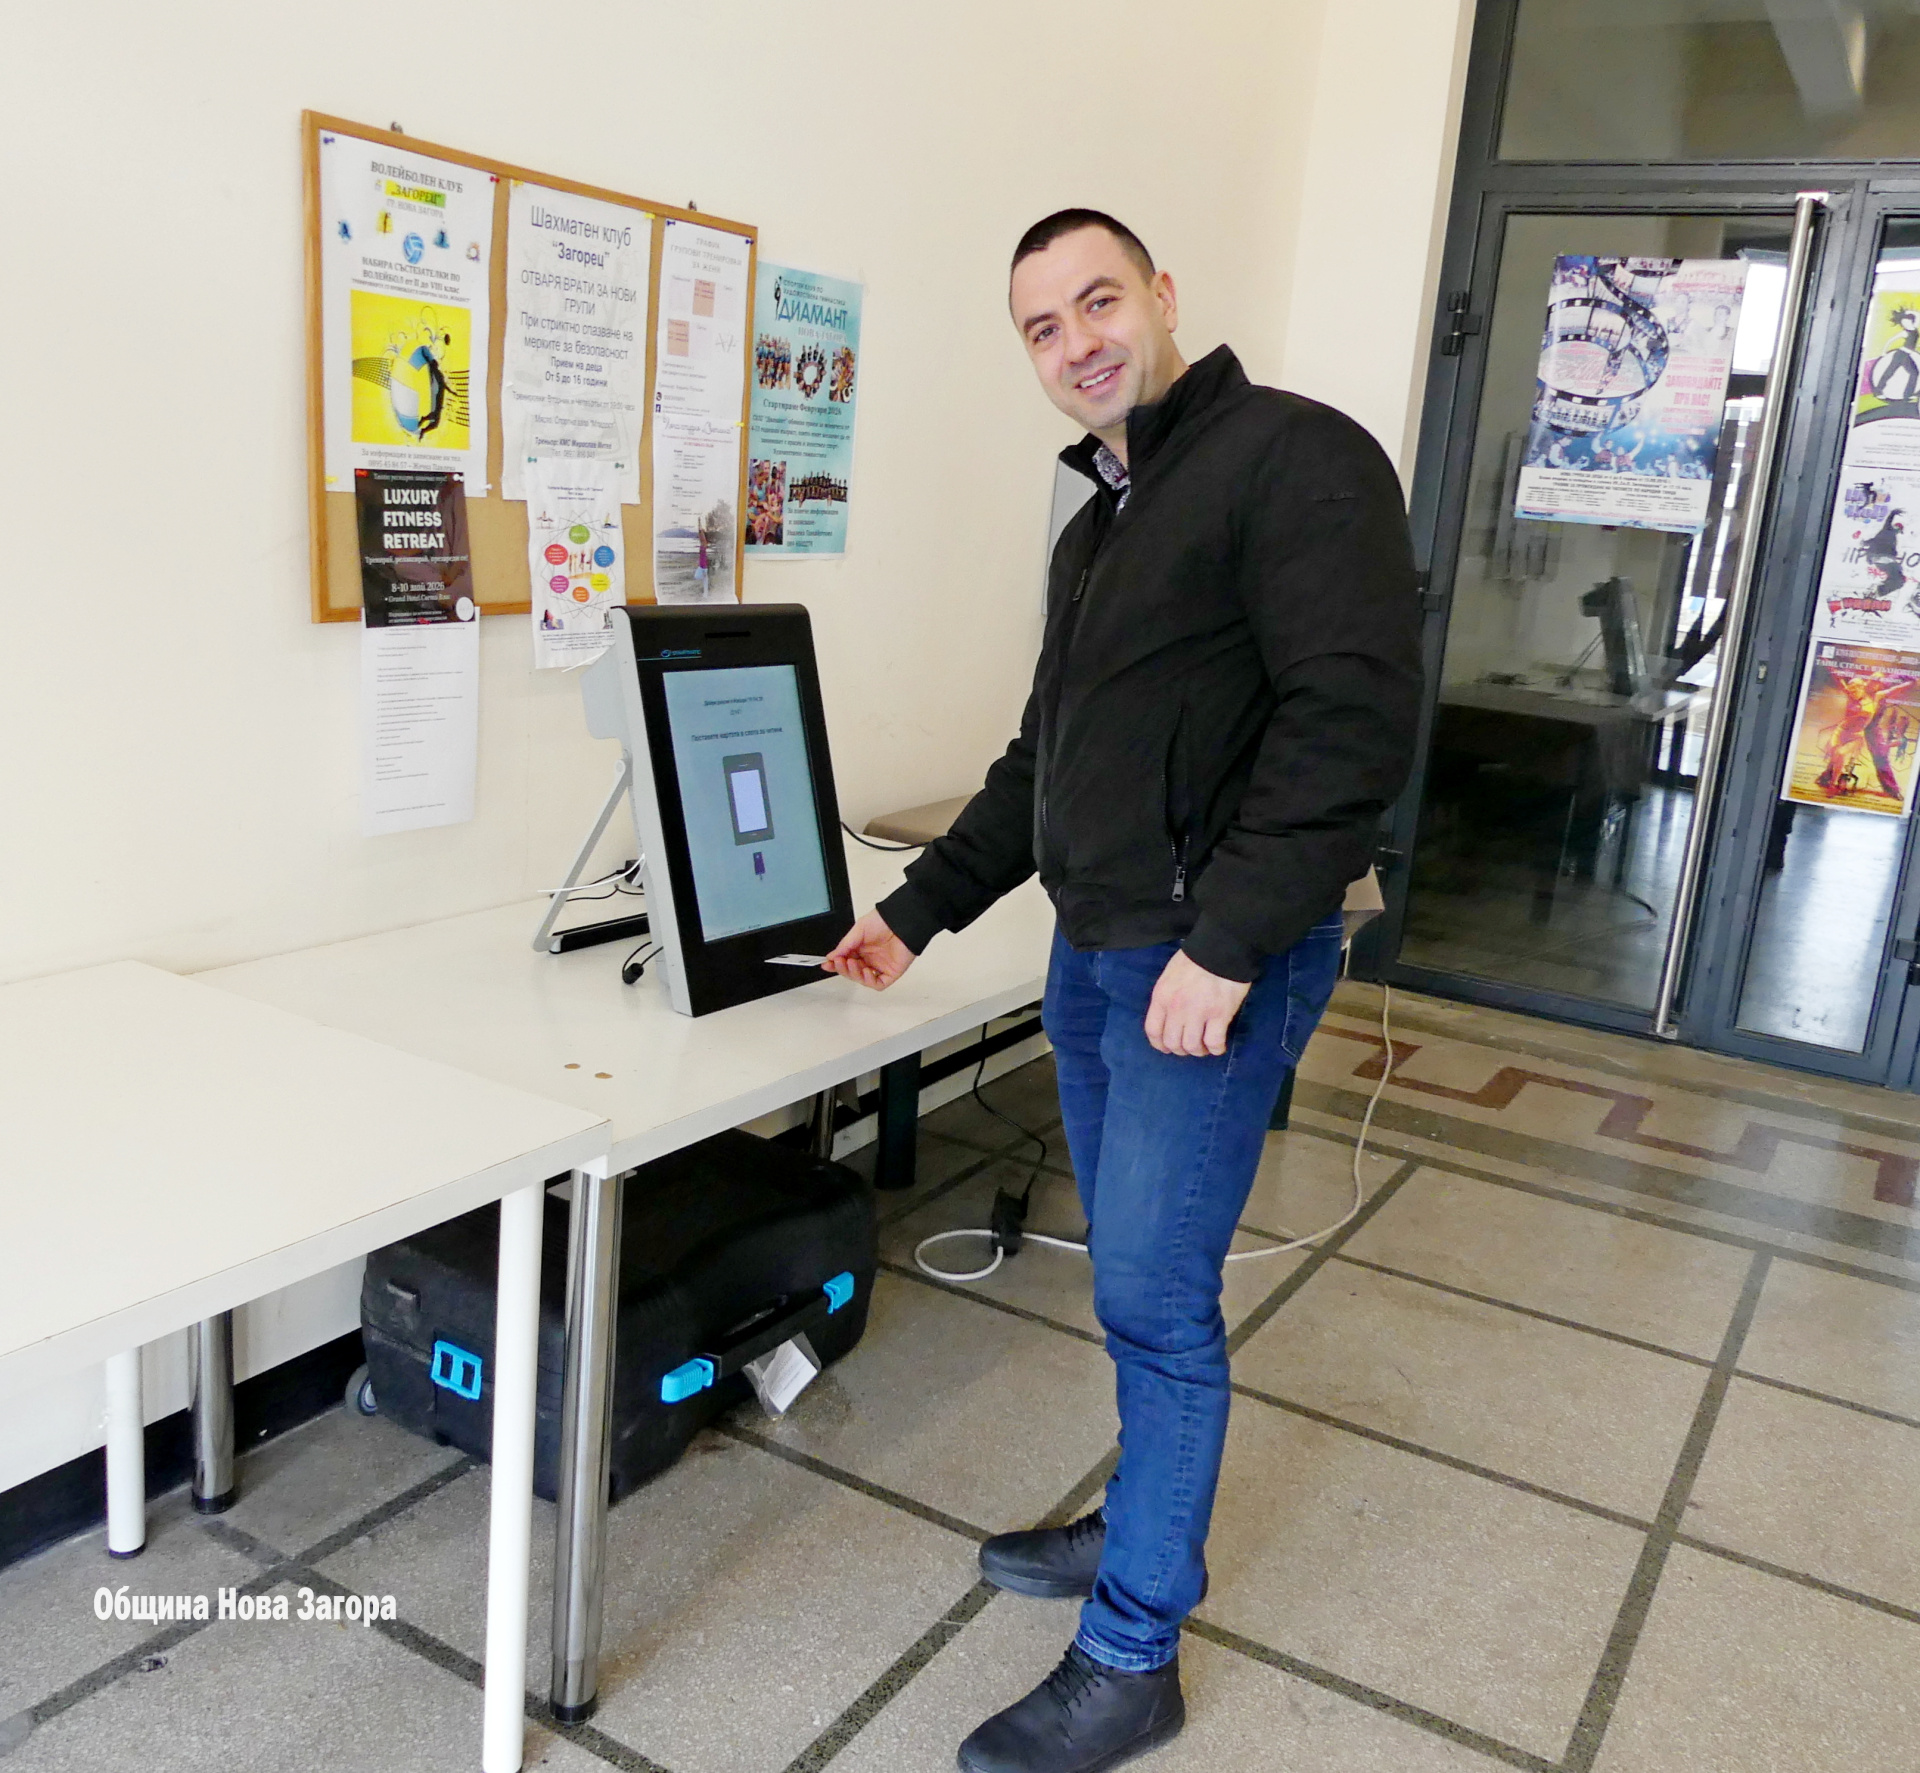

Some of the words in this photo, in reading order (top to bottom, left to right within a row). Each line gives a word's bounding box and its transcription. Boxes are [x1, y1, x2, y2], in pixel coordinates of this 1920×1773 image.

[371, 161, 437, 186] ВОЛЕЙБОЛЕН
[438, 180, 463, 193] КЛУБ
[531, 205, 600, 240] Шахматен
[603, 226, 631, 250] клуб
[362, 257, 392, 270] НАБИРА
[395, 263, 449, 280] СЪСТЕЗАТЕЛКИ
[450, 272, 460, 282] ПО
[363, 270, 404, 284] ВОЛЕЙБОЛ
[521, 269, 561, 290] ОТВАРЯ
[563, 277, 595, 295] ВРАТИ
[597, 283, 609, 298] ЗА
[611, 287, 637, 302] НОВИ
[564, 298, 596, 316] ГРУПИ
[778, 297, 848, 330] ДИАМАНТ
[520, 311, 539, 330] При
[541, 318, 580, 334] стриктно
[582, 324, 621, 340] спазване
[623, 331, 634, 342] на
[524, 337, 561, 352] мерките
[563, 344, 573, 353] за
[575, 340, 628, 360] безопасност
[551, 356, 574, 369] Прием
[576, 361, 584, 370] на
[586, 363, 603, 373] деца
[545, 371, 554, 381] От
[561, 374, 571, 384] до
[583, 377, 608, 387] години
[384, 488, 439, 505] LUXURY
[383, 511, 443, 527] FITNESS
[383, 533, 445, 549] RETREAT
[391, 582, 409, 593] 8-10
[410, 582, 426, 592] май
[426, 581, 445, 592] 2026
